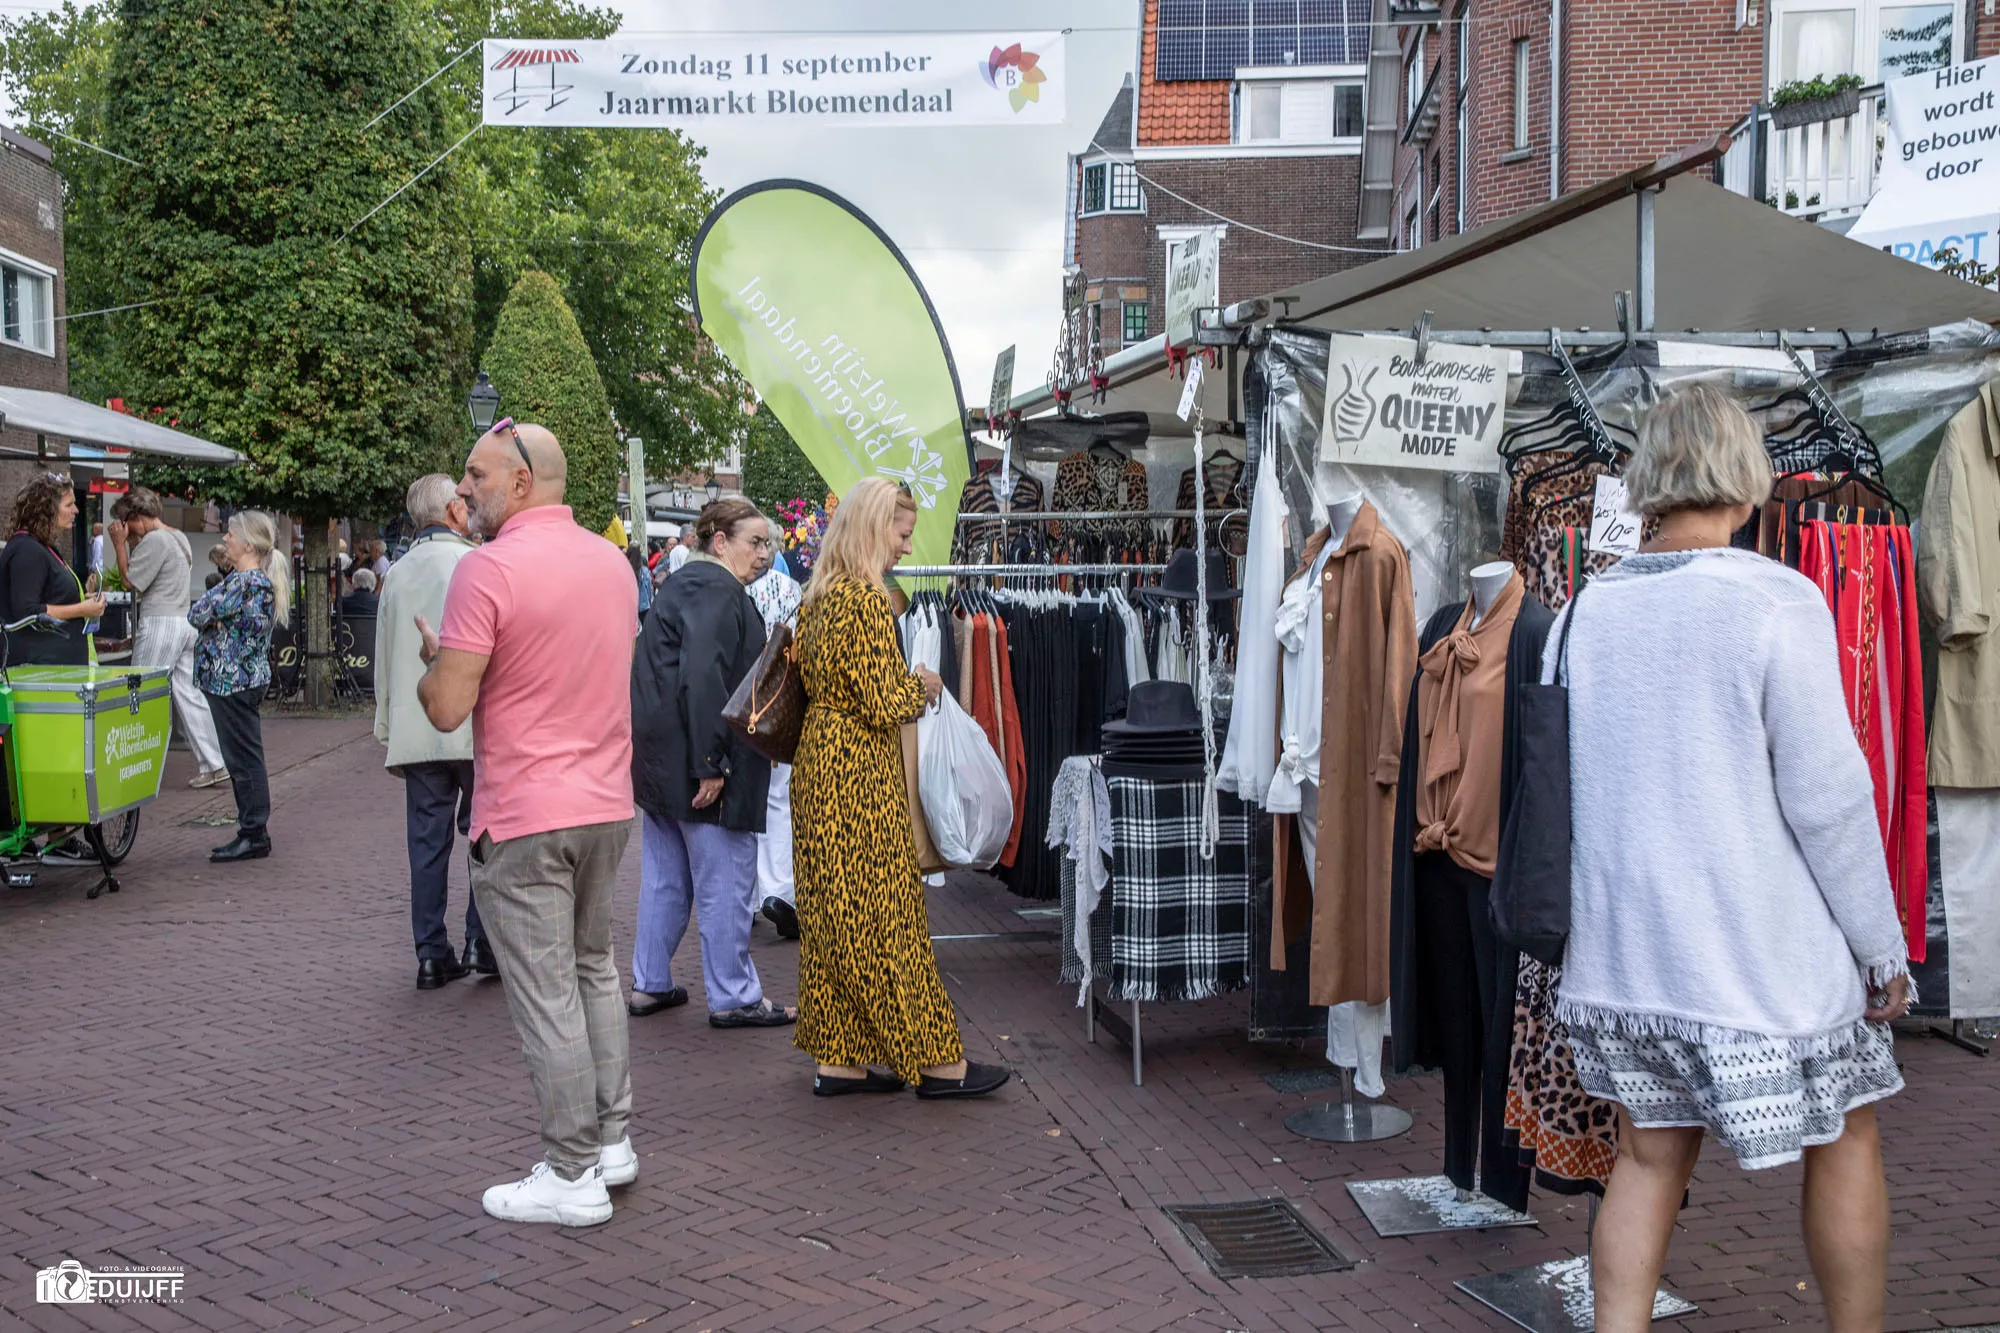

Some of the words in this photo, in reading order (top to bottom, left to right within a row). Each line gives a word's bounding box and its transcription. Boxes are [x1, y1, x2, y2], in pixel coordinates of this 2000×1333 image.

[620, 53, 732, 81] Zondag
[744, 53, 768, 75] 11
[782, 51, 932, 80] september
[1006, 69, 1016, 86] B
[1935, 64, 1987, 90] Hier
[599, 89, 757, 115] Jaarmarkt
[767, 88, 952, 114] Bloemendaal
[1924, 89, 1995, 122] wordt
[1902, 124, 2000, 162] gebouw
[1926, 158, 1984, 181] door
[1389, 355, 1497, 384] BOURGONDISCHE
[1380, 393, 1497, 442] QUEENY
[1400, 433, 1457, 457] MODE
[119, 722, 145, 743] Welzijn
[119, 730, 161, 759] Bloemendaal
